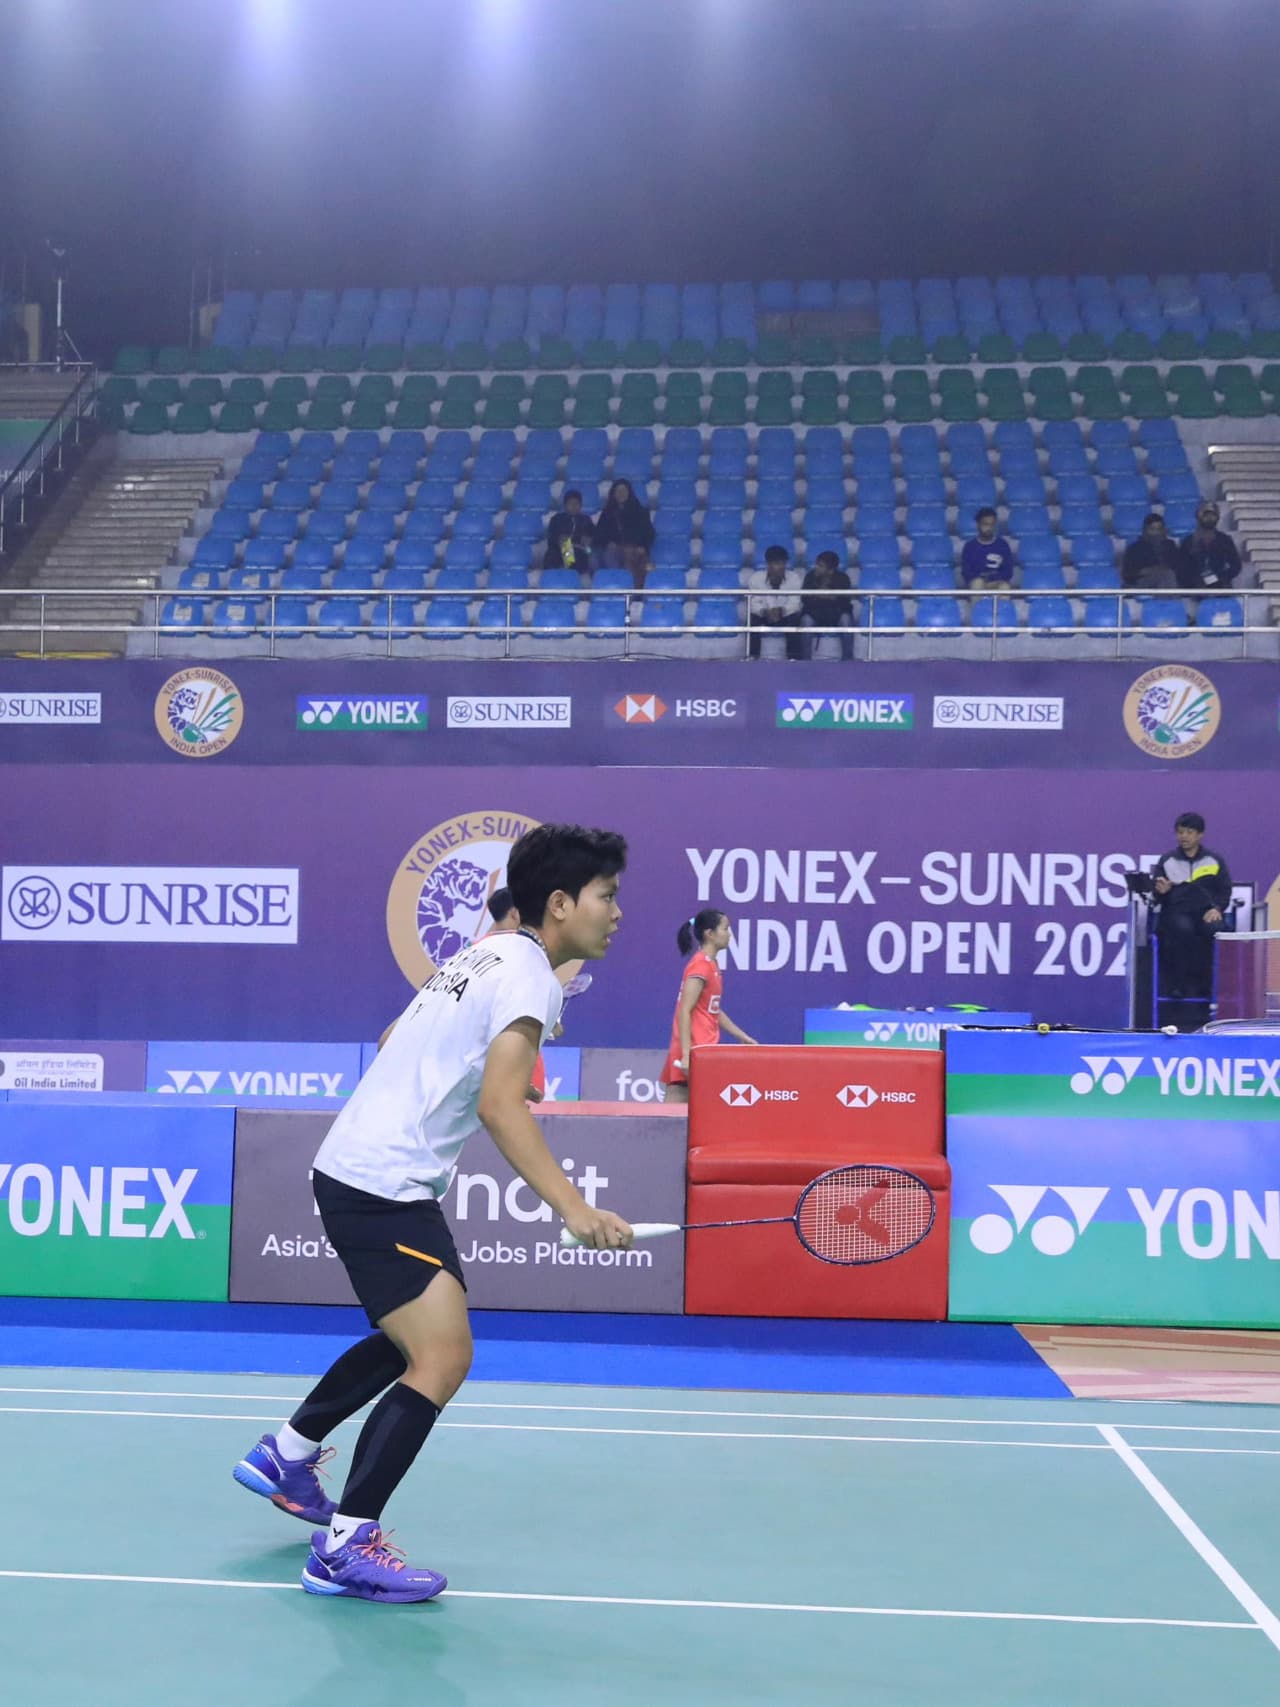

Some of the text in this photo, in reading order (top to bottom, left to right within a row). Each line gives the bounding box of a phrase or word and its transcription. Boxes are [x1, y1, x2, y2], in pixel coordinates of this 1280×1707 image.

[8, 699, 99, 717] SUNRISE
[347, 701, 419, 724] YONEX
[474, 702, 568, 721] SUNRISE
[675, 699, 737, 718] HSBC
[829, 700, 904, 723] YONEX
[961, 703, 1060, 723] SUNRISE
[170, 736, 227, 755] INDIA OPEN
[406, 816, 534, 875] YONEX-SUN
[67, 882, 292, 927] SUNRISE
[716, 919, 1128, 977] NDIA OPEN 202
[14, 1078, 97, 1089] Oil India Limited
[1152, 1056, 1280, 1098] YONEX
[764, 1090, 799, 1101] HSBC
[881, 1092, 916, 1103] HSBC
[1126, 1187, 1280, 1260] YON
[460, 1240, 528, 1264] Jobs
